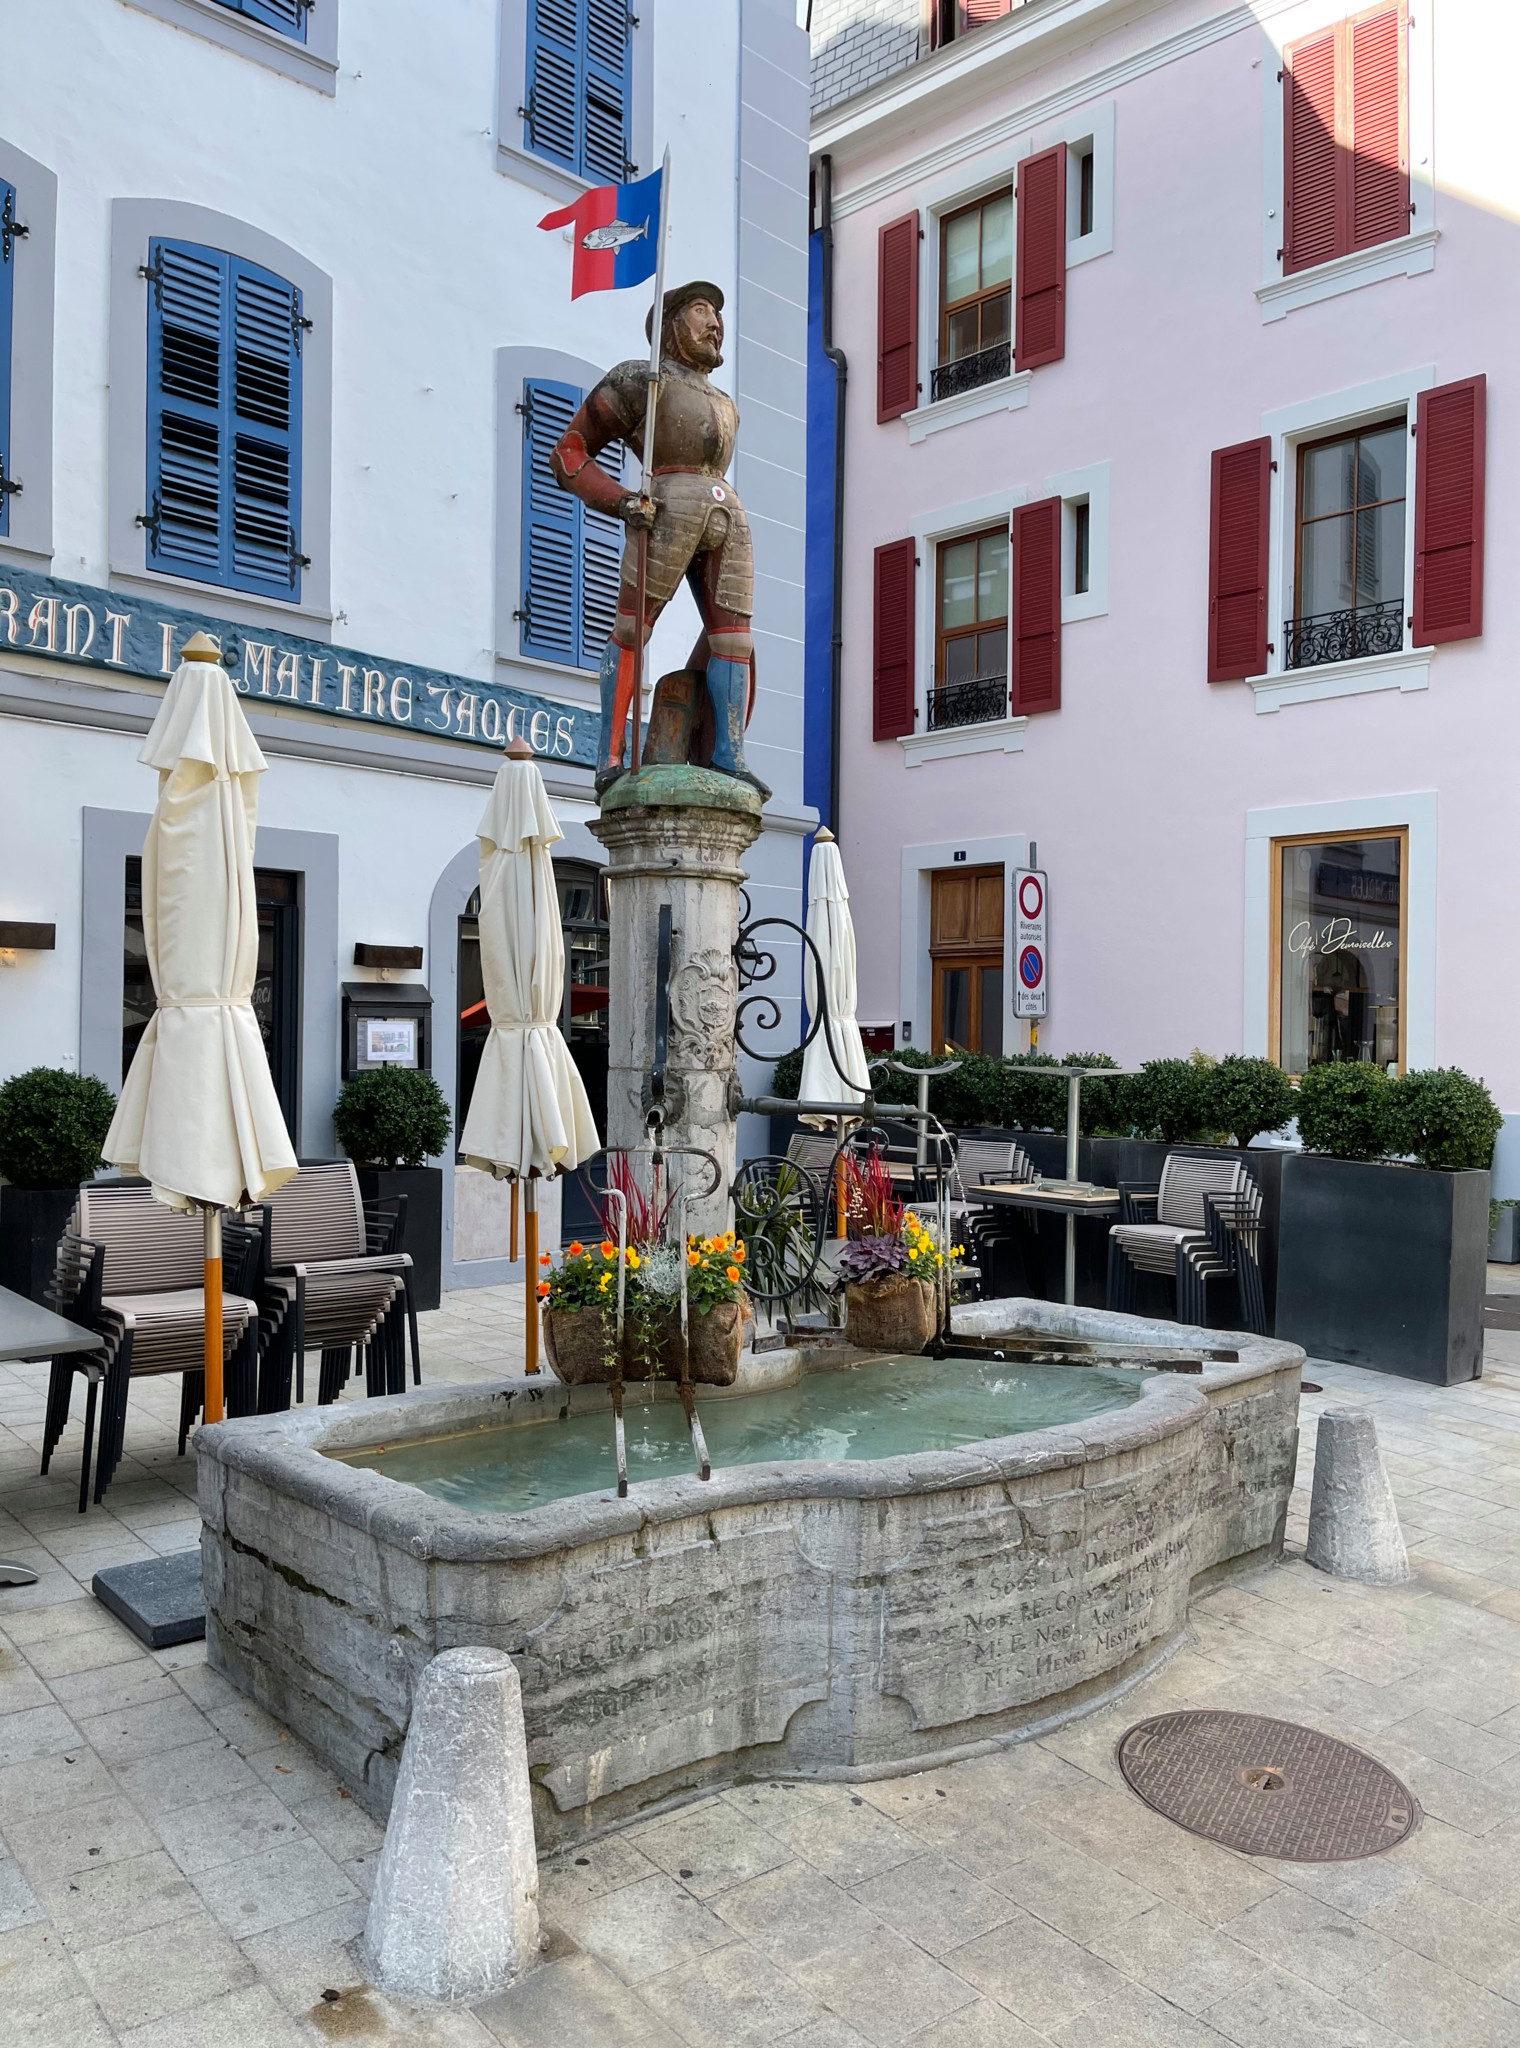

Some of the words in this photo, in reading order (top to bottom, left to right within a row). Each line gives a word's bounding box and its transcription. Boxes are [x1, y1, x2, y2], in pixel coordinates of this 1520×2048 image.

[231, 637, 413, 723] MAITRE
[424, 681, 575, 757] JAQUES
[1020, 920, 1042, 931] Riverains
[1020, 931, 1042, 941] autorisés
[1321, 917, 1393, 954] Demoiselles
[1021, 991, 1029, 1000] des
[1030, 991, 1041, 1000] deux
[1025, 1001, 1037, 1011] côtés
